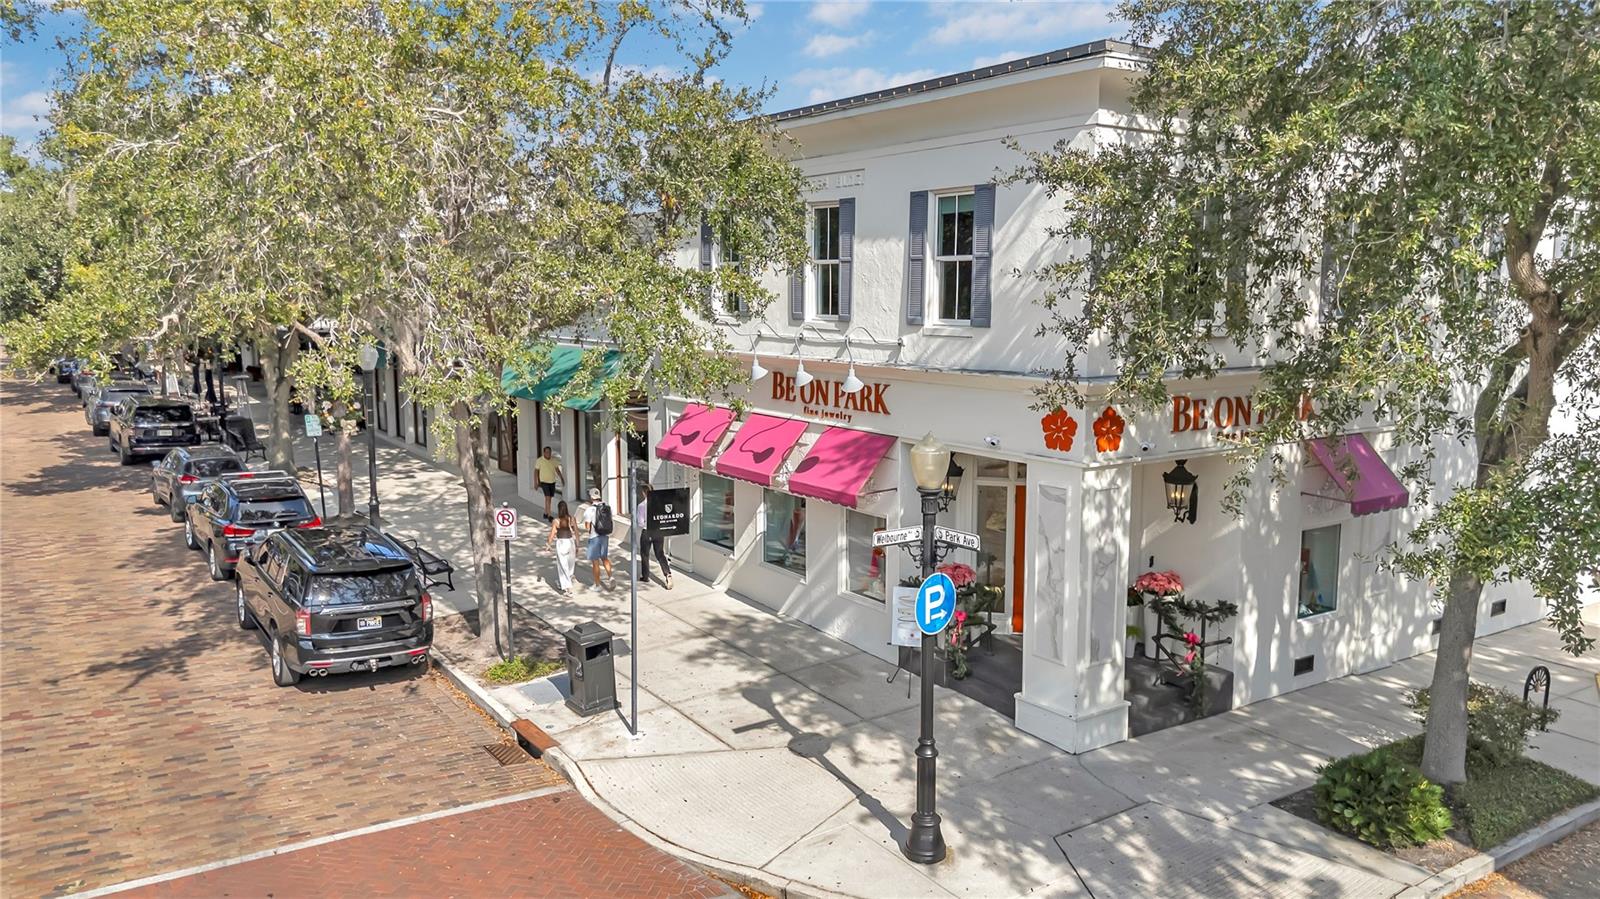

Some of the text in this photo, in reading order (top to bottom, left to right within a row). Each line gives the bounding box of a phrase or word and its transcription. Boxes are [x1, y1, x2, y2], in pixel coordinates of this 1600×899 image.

[771, 371, 891, 415] BE ON PARK
[803, 406, 852, 423] fine jewelry
[1171, 395, 1208, 433] BE
[1213, 396, 1252, 428] ON
[876, 529, 908, 544] Welbourne
[945, 531, 960, 544] Park
[963, 534, 975, 546] Ave
[925, 584, 945, 625] P
